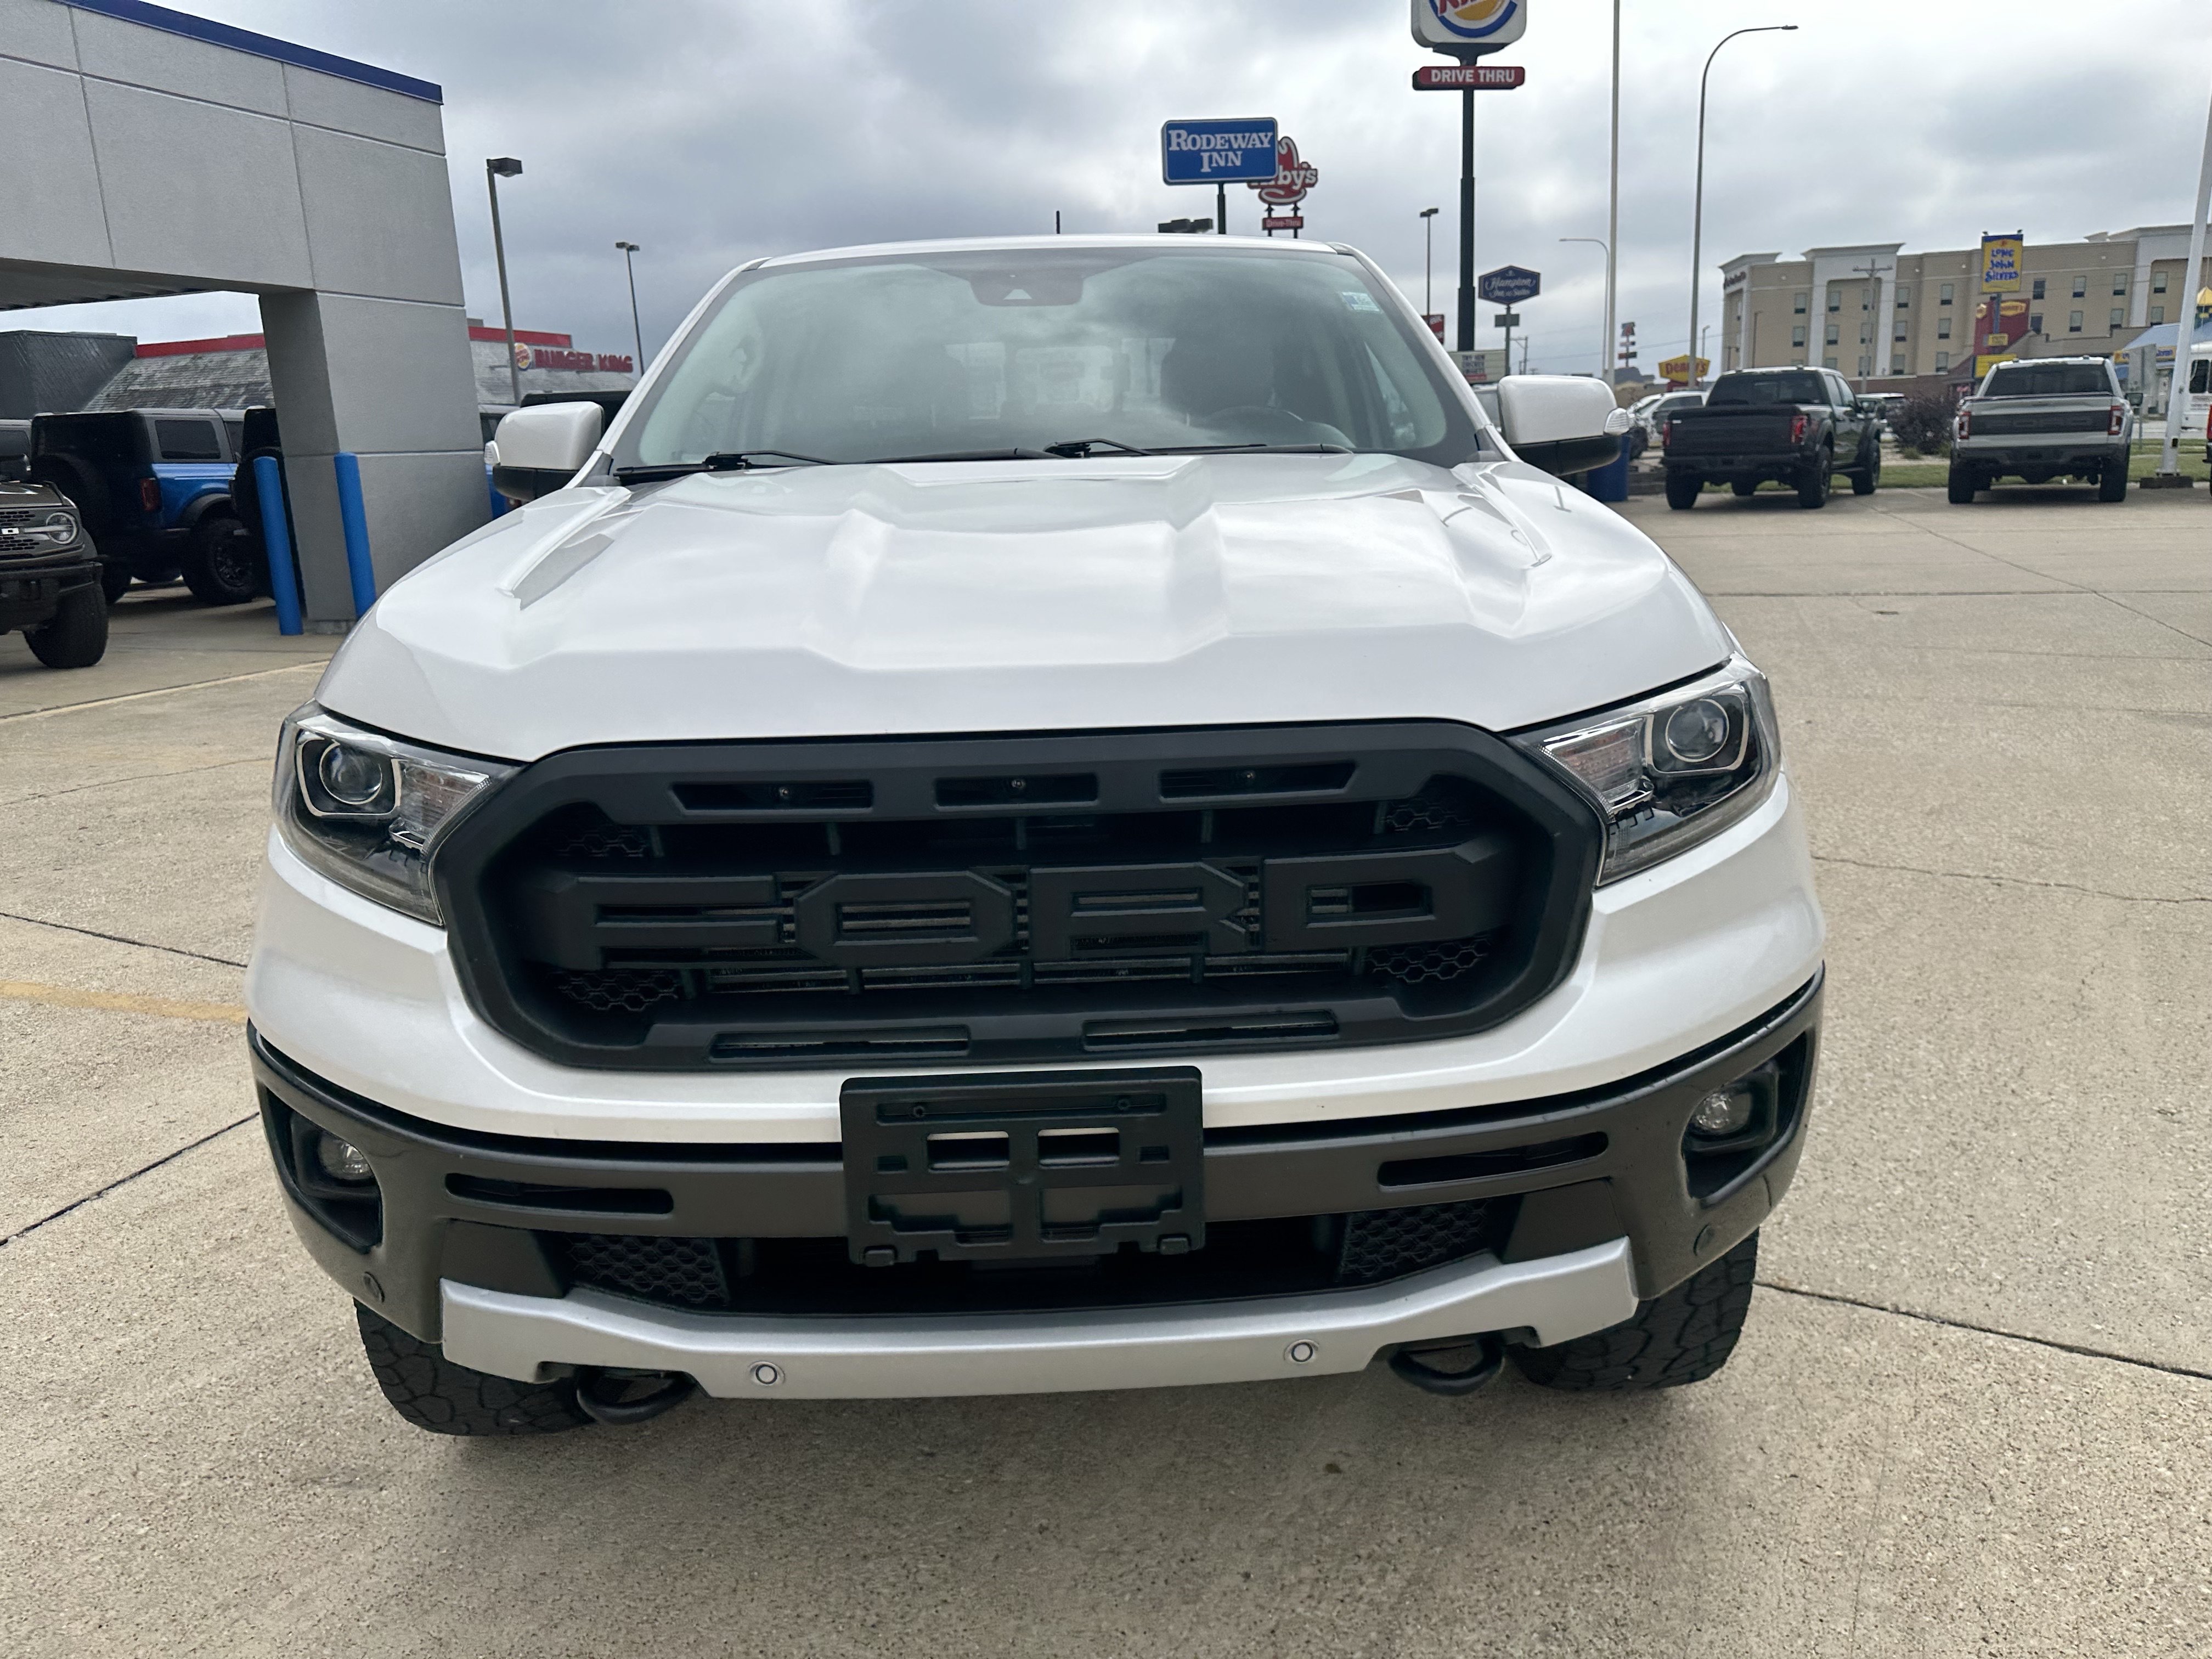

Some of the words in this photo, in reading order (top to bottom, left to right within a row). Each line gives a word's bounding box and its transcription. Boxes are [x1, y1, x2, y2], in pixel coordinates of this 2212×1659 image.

[1431, 70, 1475, 82] DRIVE
[1477, 70, 1515, 82] THRU
[1168, 129, 1273, 151] RODEWAY
[1200, 151, 1243, 172] INN
[1252, 162, 1317, 190] by's
[1485, 276, 1536, 290] Hampton
[534, 349, 594, 370] BURGER
[597, 353, 633, 373] KING
[540, 844, 1503, 969] FORD
